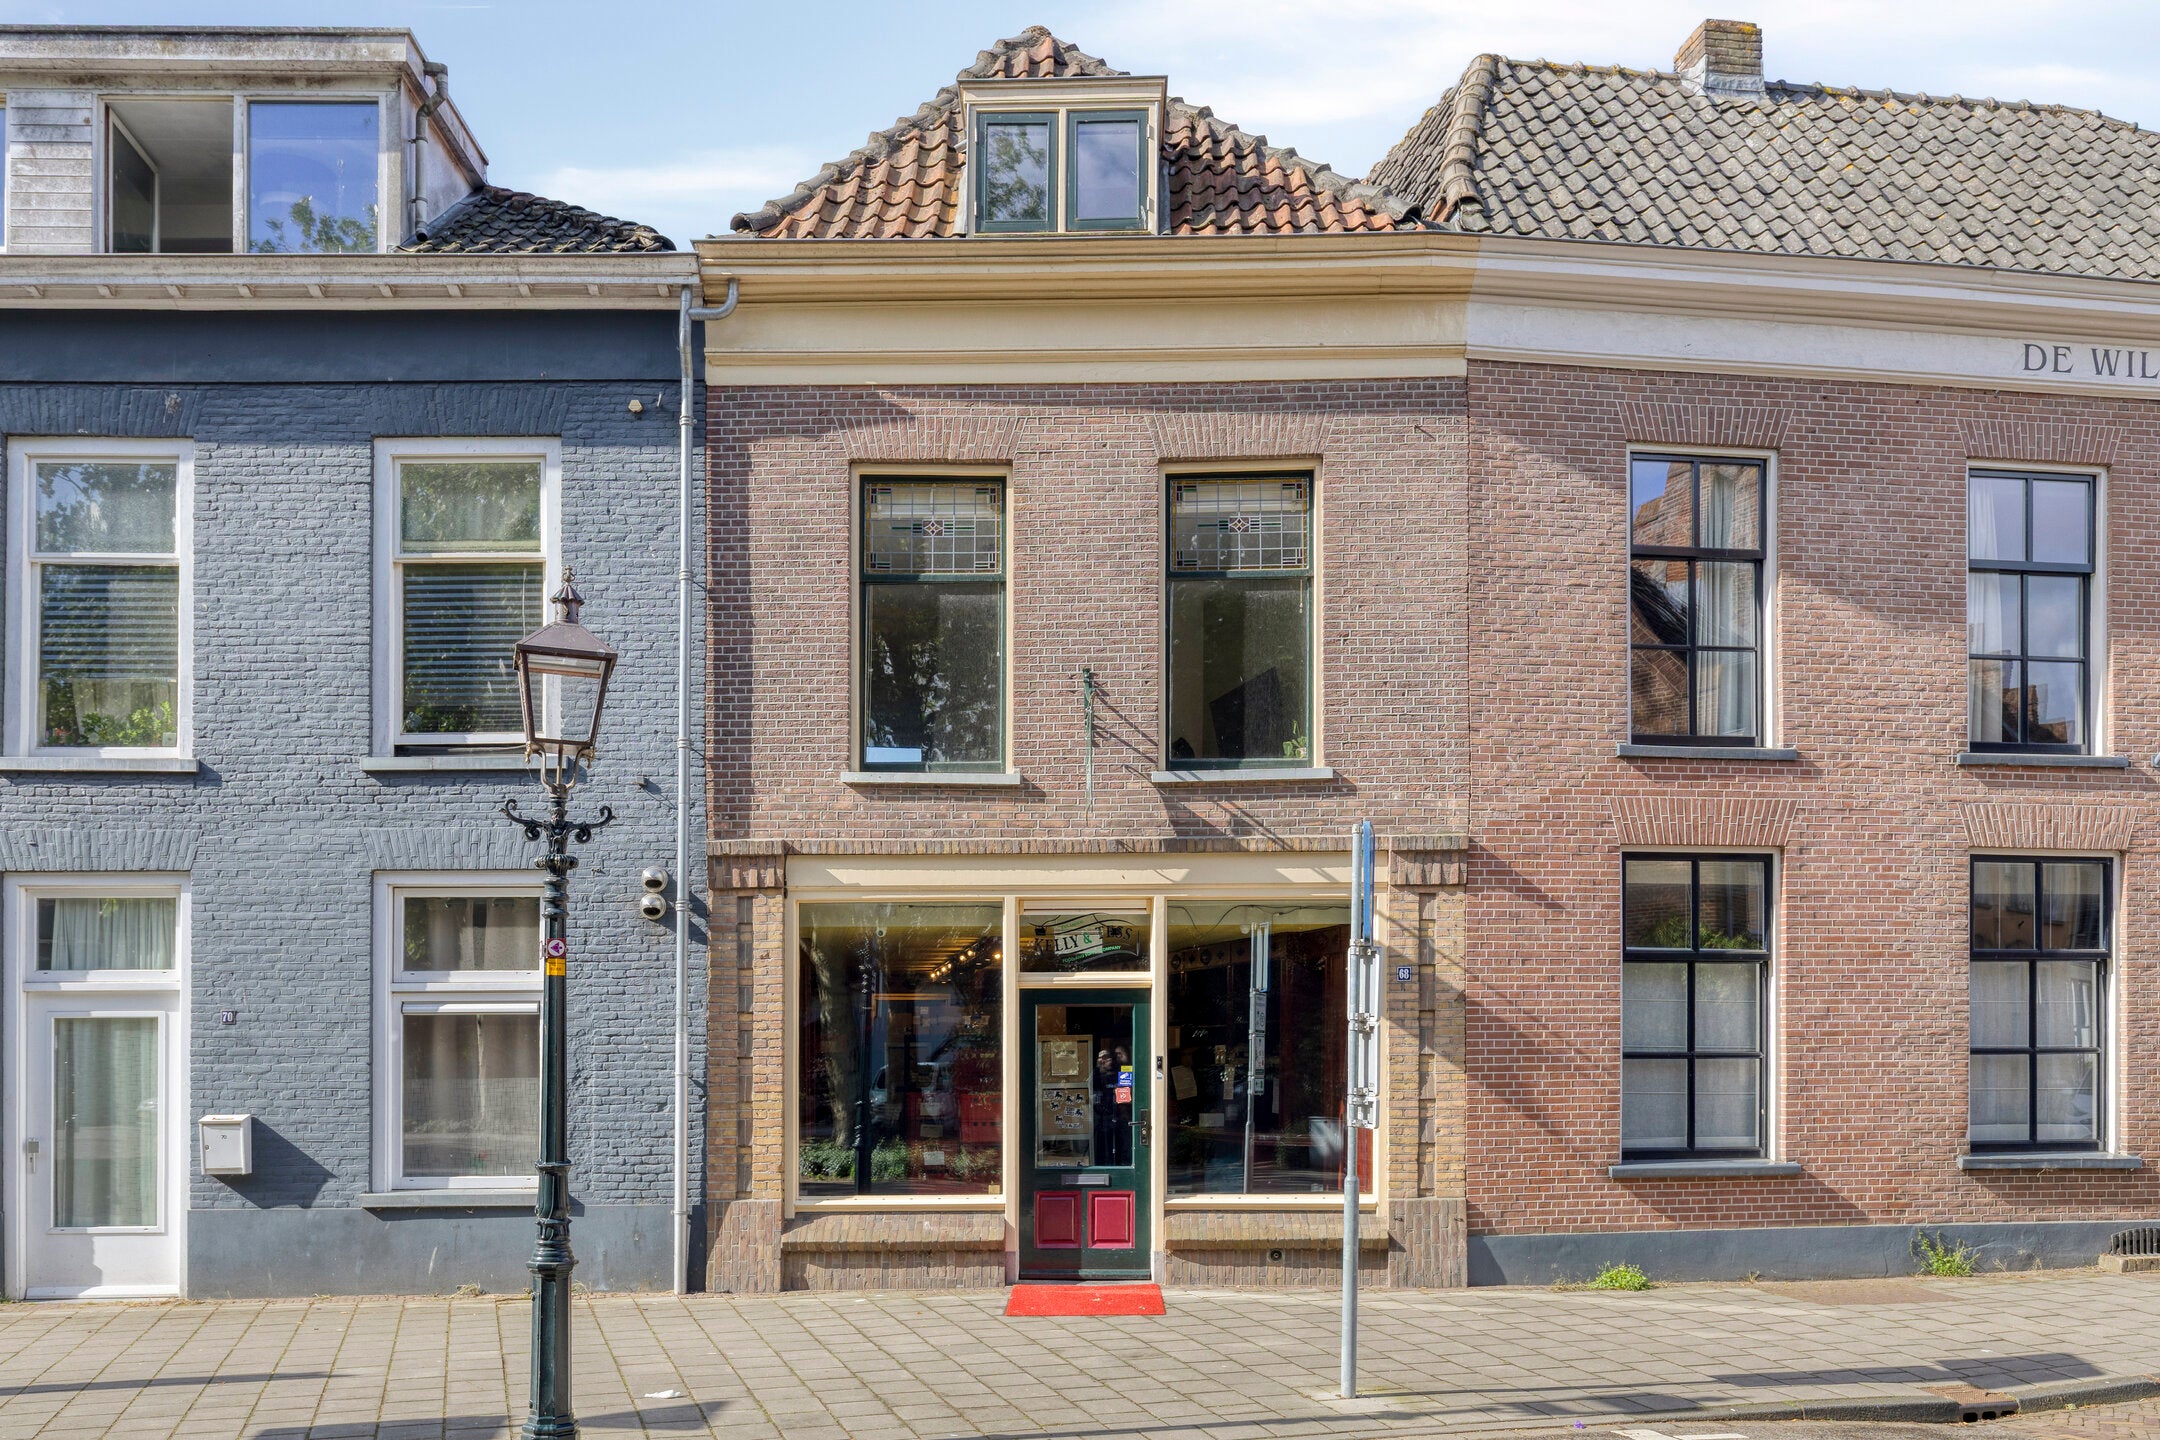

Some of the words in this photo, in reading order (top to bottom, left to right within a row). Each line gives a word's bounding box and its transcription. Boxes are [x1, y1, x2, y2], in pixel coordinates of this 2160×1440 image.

[2022, 343, 2074, 373] DE
[2090, 348, 2160, 379] WIL
[1035, 934, 1079, 953] KELLY
[1083, 932, 1092, 944] &
[1399, 968, 1409, 979] 68
[222, 1012, 233, 1022] 70
